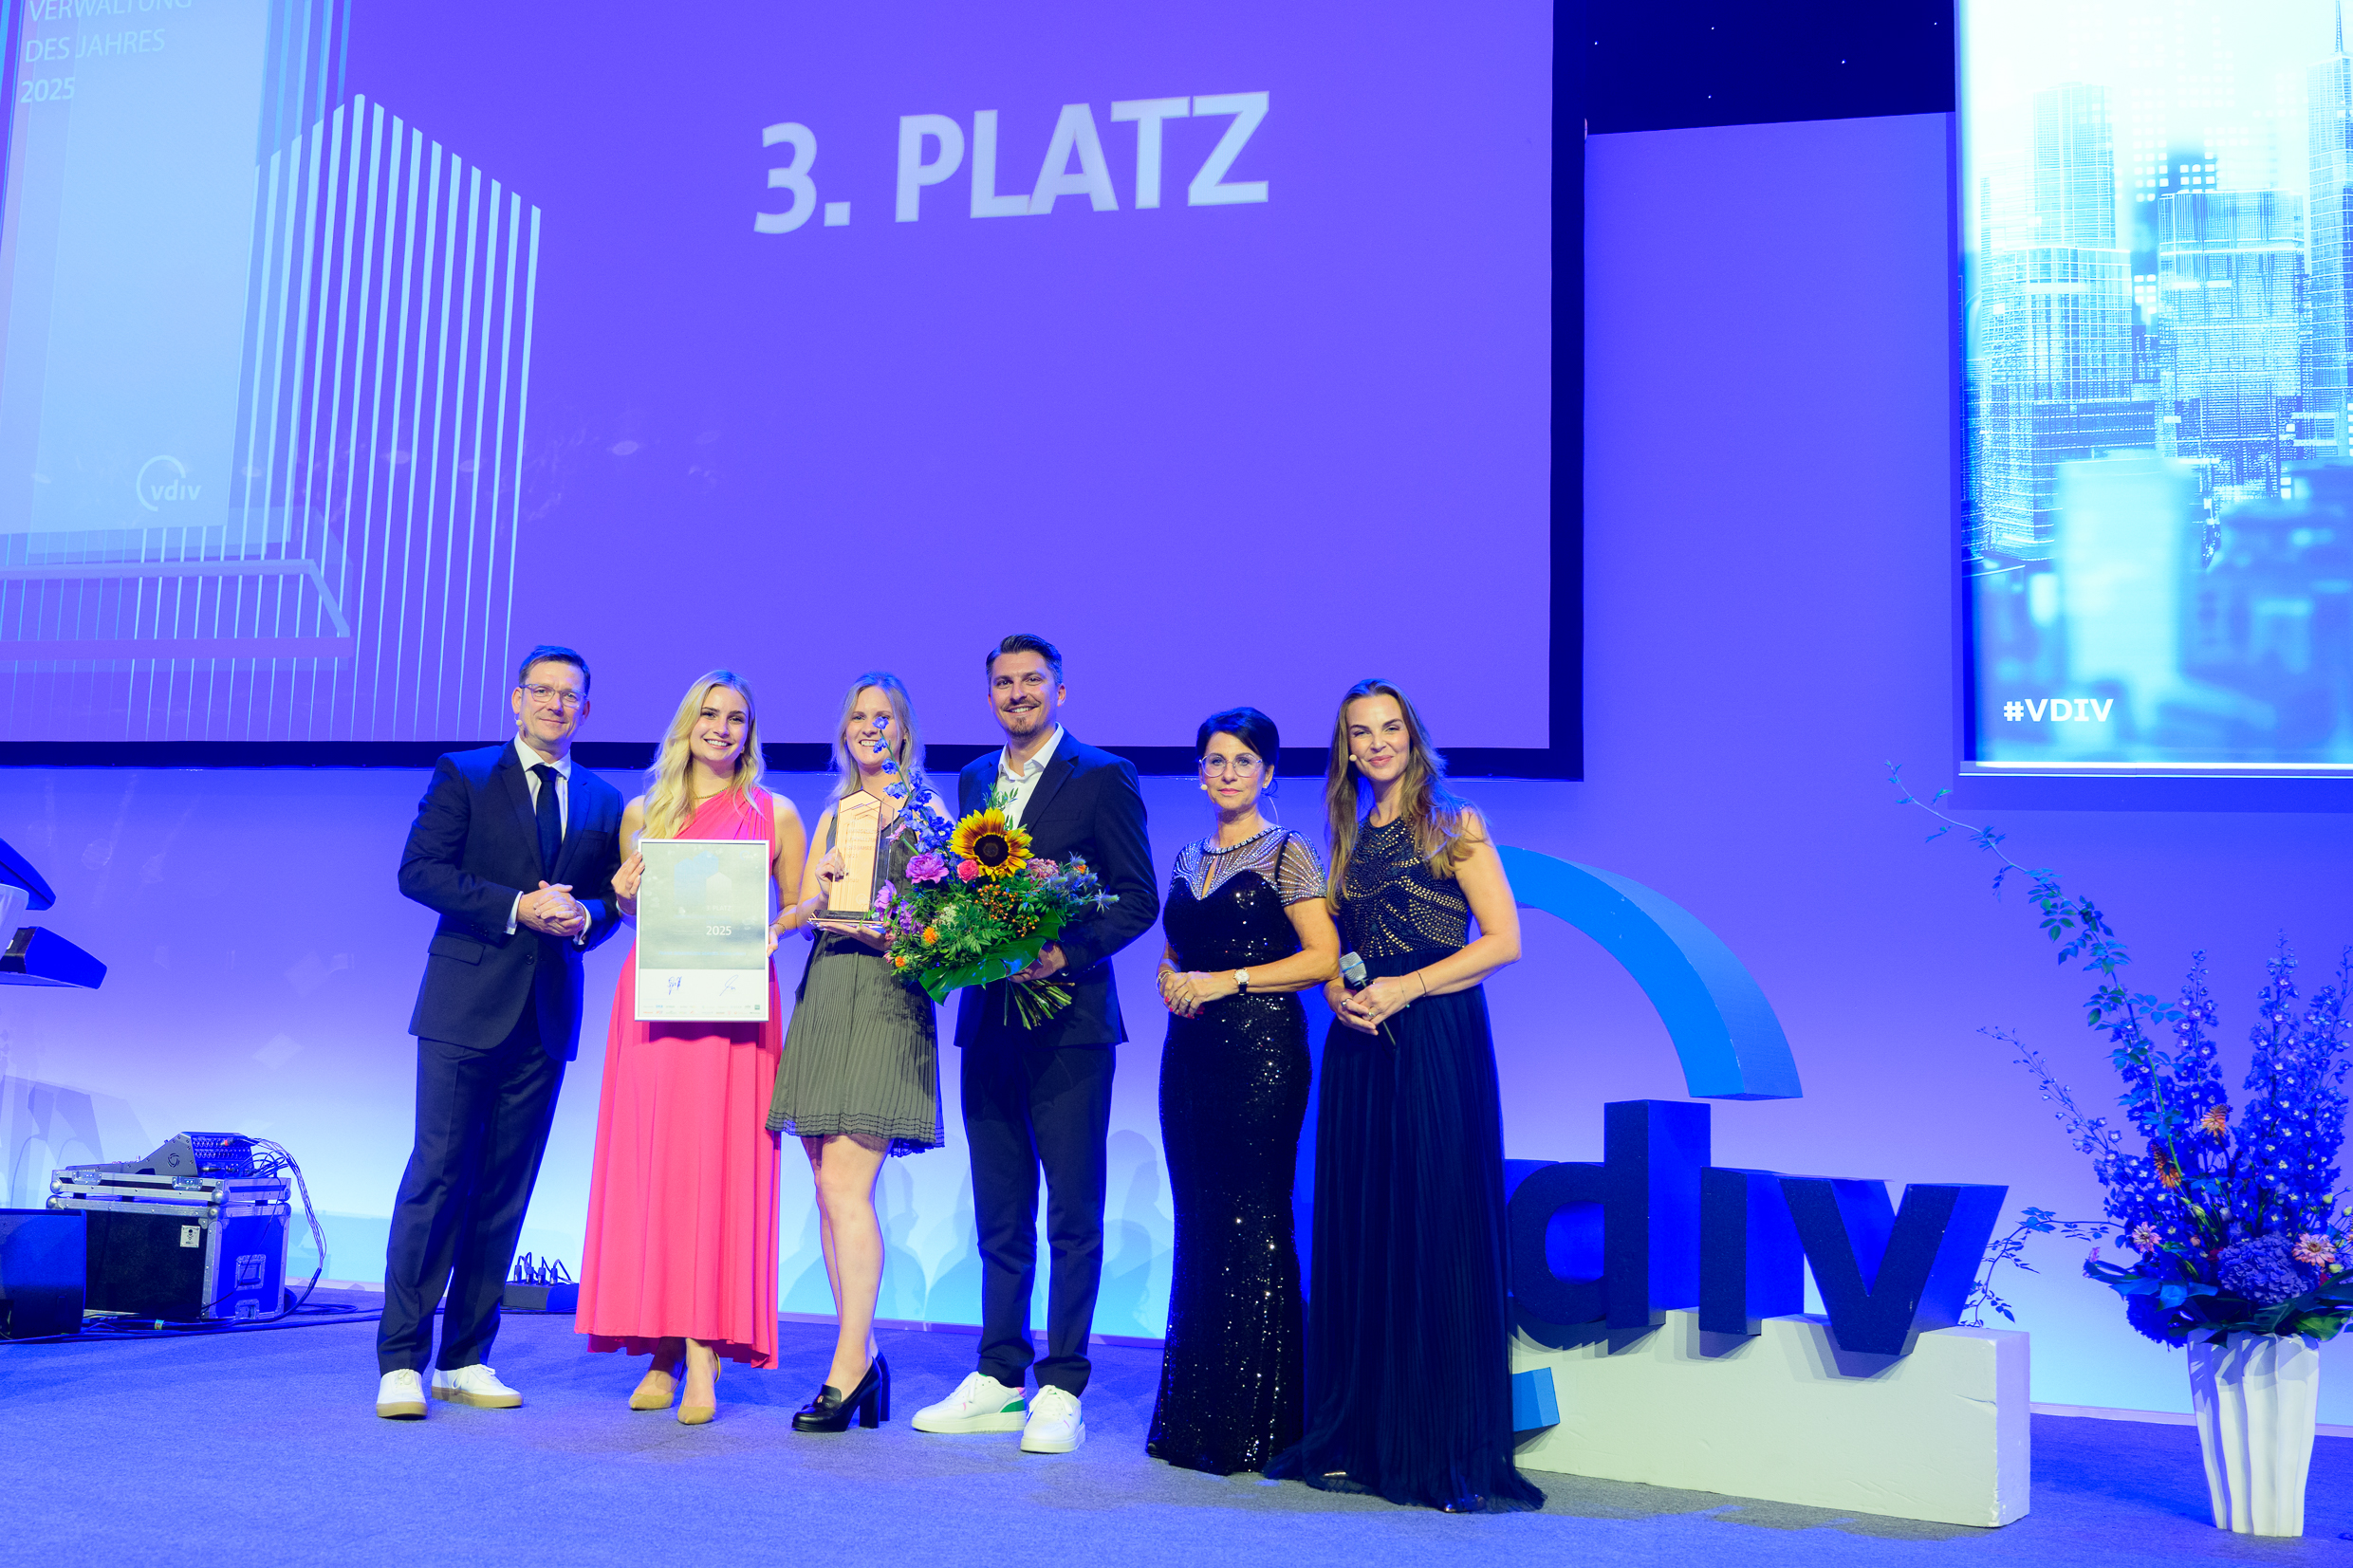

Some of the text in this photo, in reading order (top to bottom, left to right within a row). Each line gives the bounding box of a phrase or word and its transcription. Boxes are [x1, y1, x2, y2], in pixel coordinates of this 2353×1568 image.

[25, 28, 166, 63] DES JAHRES
[20, 77, 75, 103] 2025
[753, 90, 1269, 234] 3. PLATZ
[151, 479, 202, 501] vdiv
[2003, 698, 2114, 722] #VDIV
[706, 925, 732, 936] 2025
[1506, 1099, 2009, 1356] div
